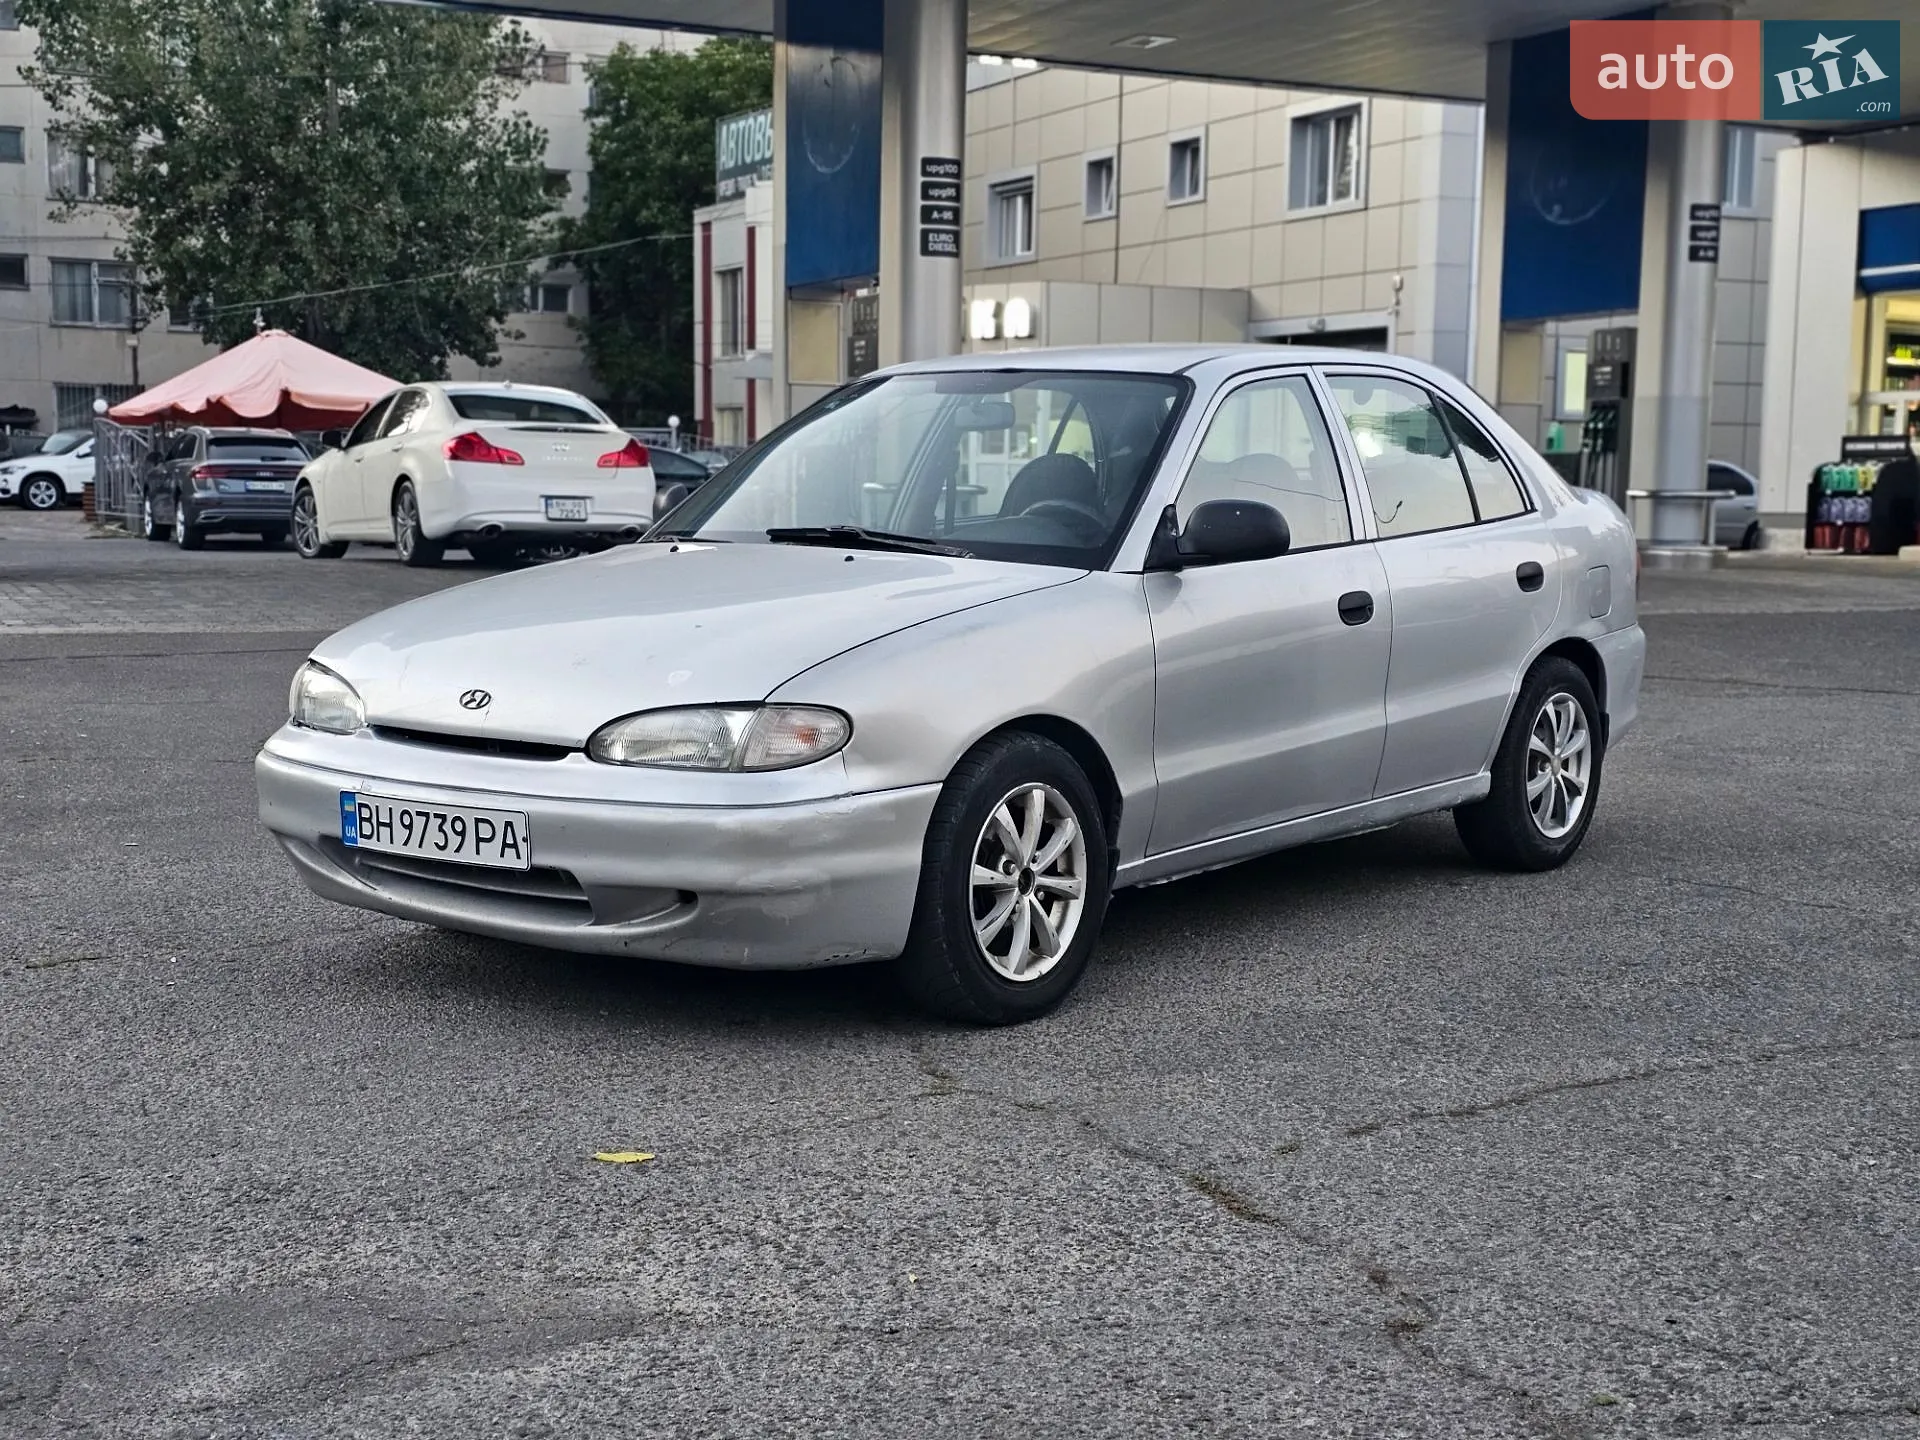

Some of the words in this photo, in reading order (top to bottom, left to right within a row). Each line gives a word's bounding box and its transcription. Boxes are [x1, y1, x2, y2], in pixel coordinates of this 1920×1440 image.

[926, 164, 958, 174] upg100
[928, 233, 954, 242] EURO
[928, 243, 958, 252] DIESEL
[345, 826, 357, 839] UA
